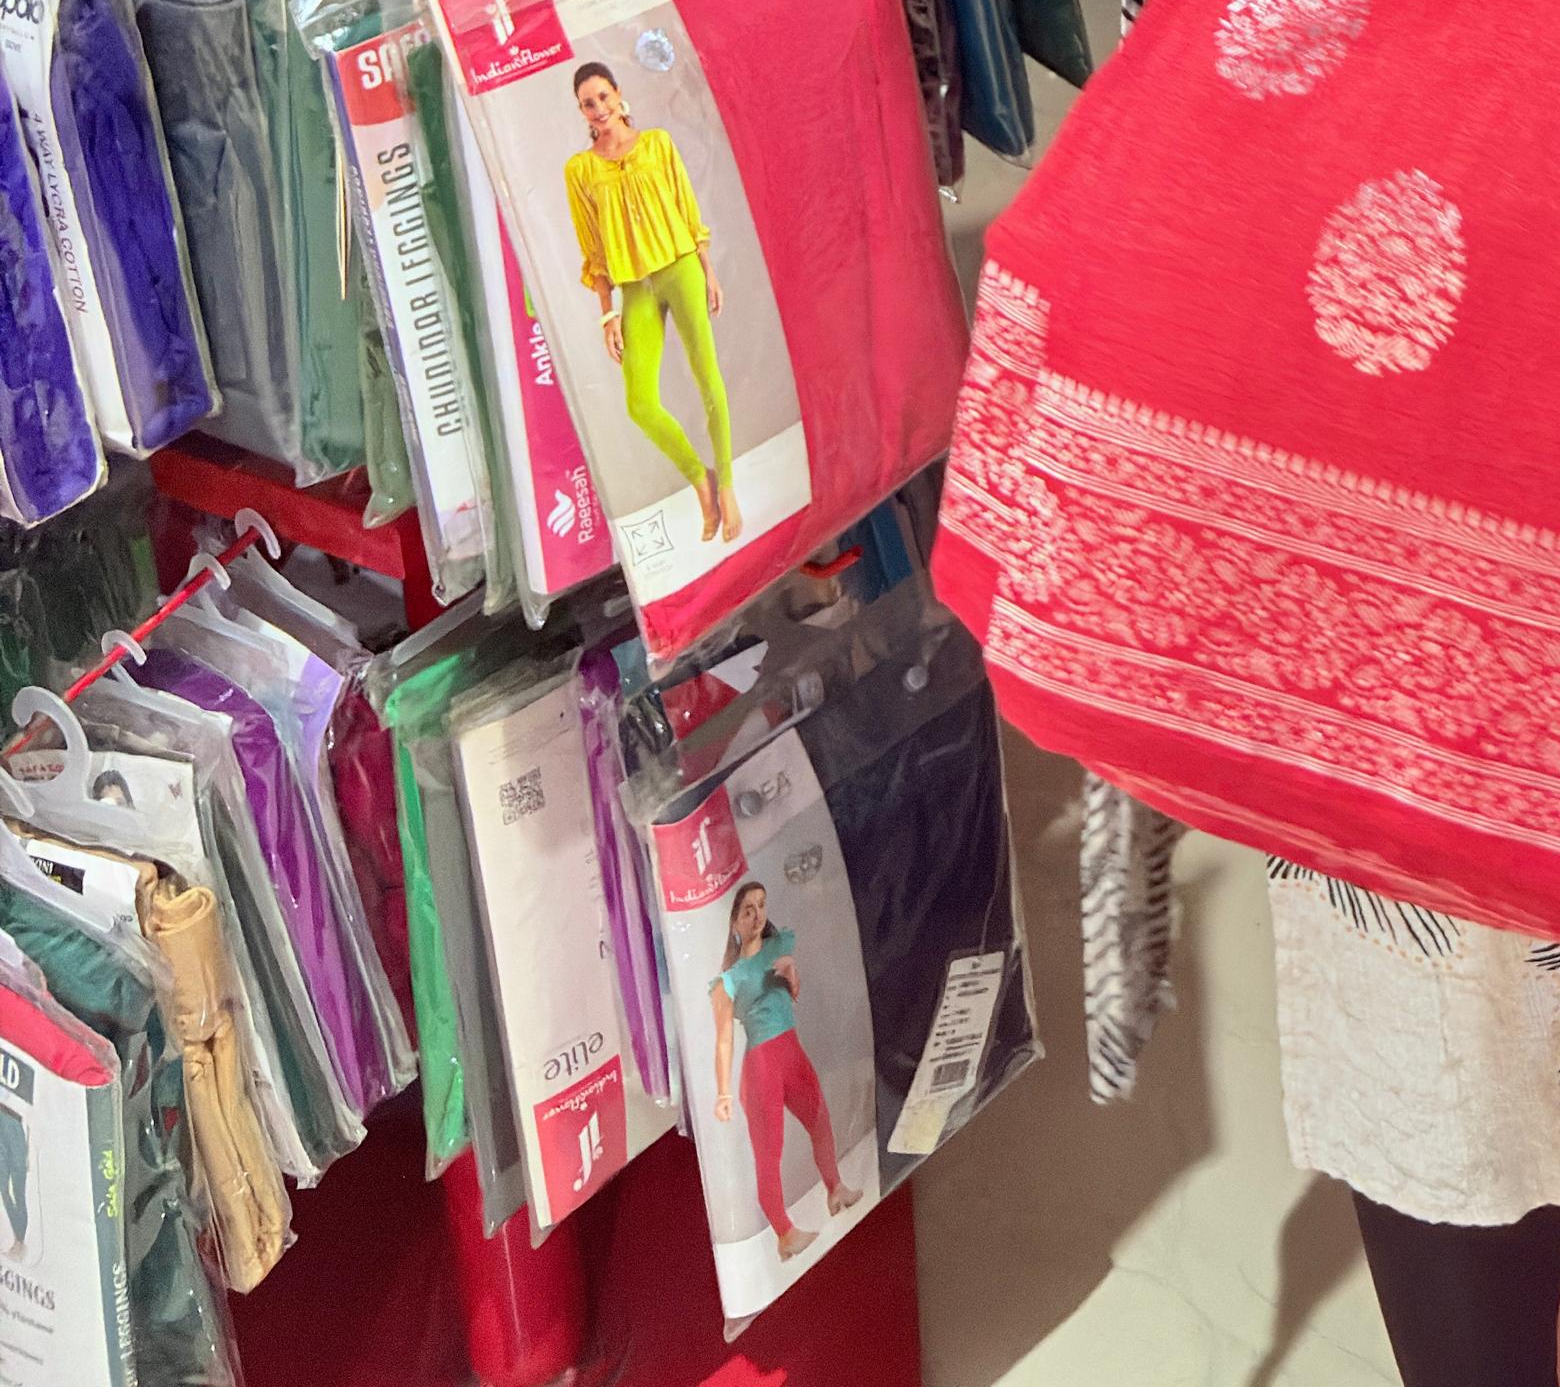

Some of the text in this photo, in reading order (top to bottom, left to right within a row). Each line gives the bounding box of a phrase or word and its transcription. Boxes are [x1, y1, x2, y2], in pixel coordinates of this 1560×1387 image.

[36, 129, 56, 168] WAY
[47, 172, 69, 233] LYCRA
[60, 237, 88, 314] COTTON
[571, 465, 595, 544] Raeesah
[543, 1031, 604, 1081] elite
